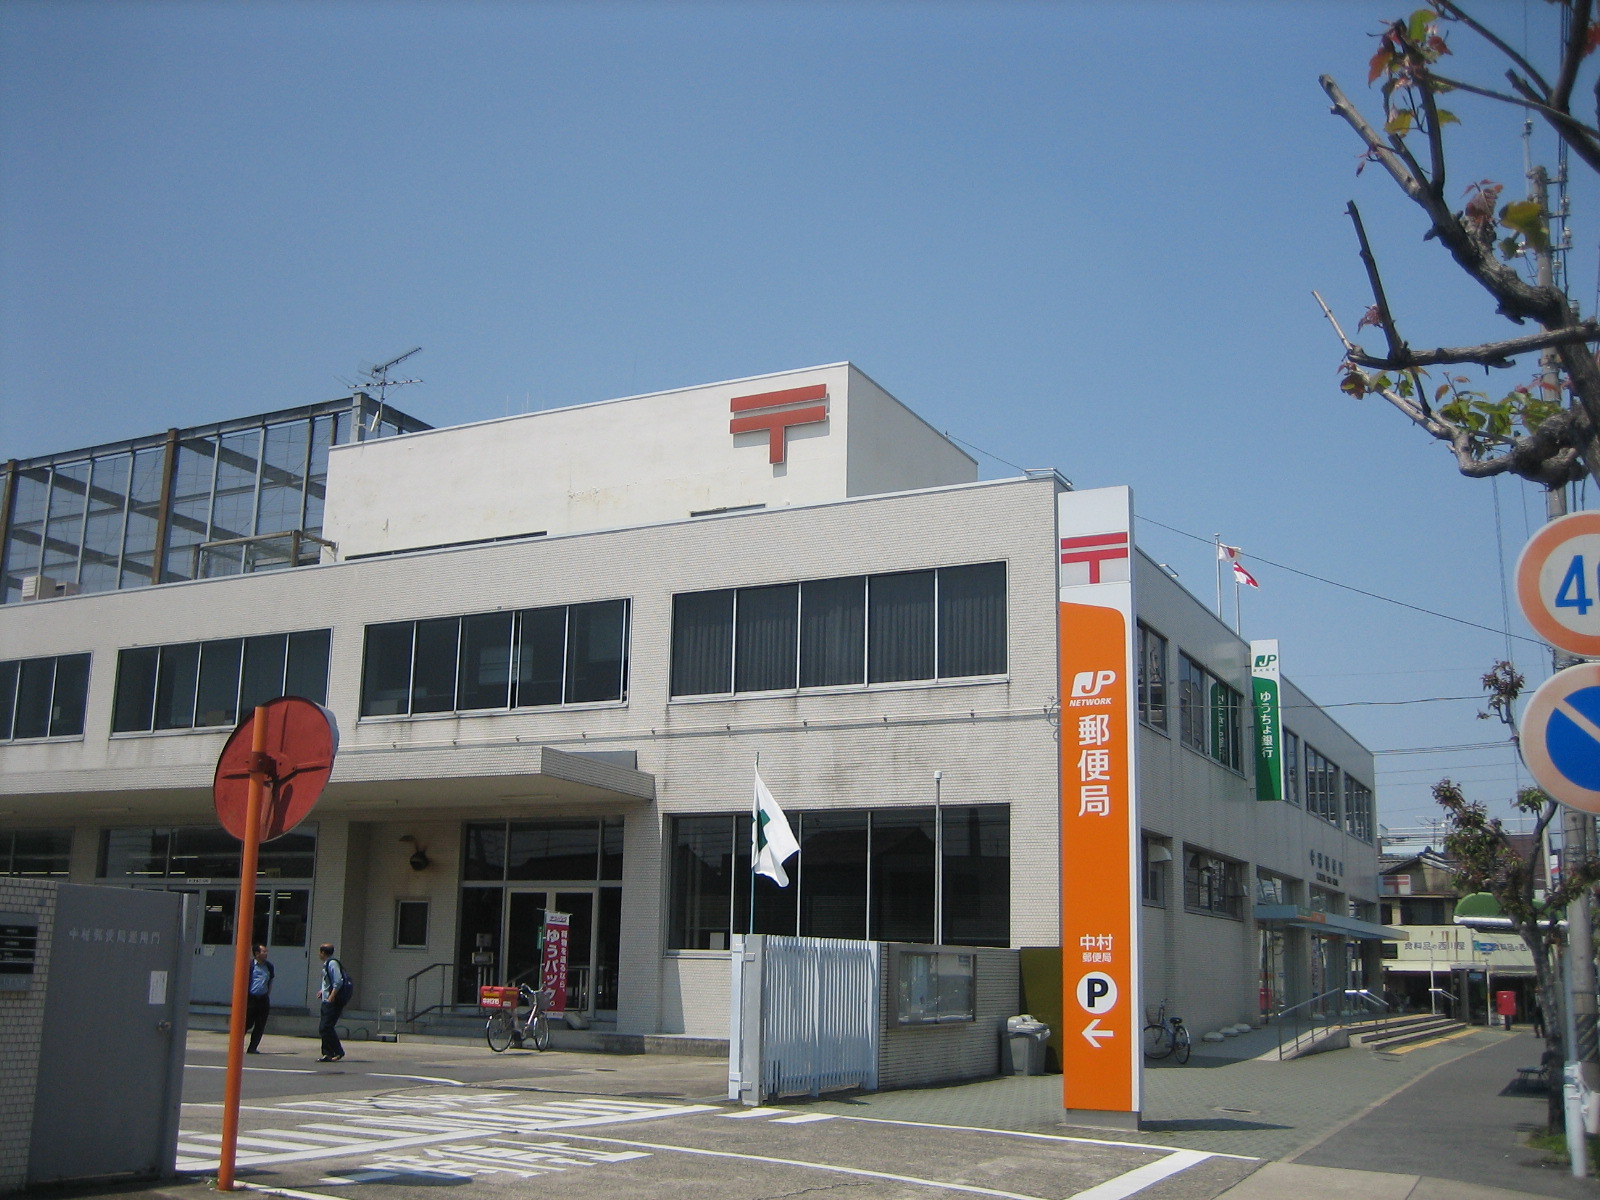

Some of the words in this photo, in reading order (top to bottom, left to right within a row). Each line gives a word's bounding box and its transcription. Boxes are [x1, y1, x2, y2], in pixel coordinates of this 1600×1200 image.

[1555, 554, 1600, 615] 4
[1255, 654, 1277, 668] JP
[1071, 670, 1117, 698] JP
[1069, 697, 1112, 707] NETWORK
[1260, 691, 1274, 759] ゆうちょ銀行
[1077, 714, 1111, 817] 郵便局
[1079, 933, 1114, 951] 中村
[1082, 952, 1113, 963] 郵便局
[1087, 978, 1109, 1008] P
